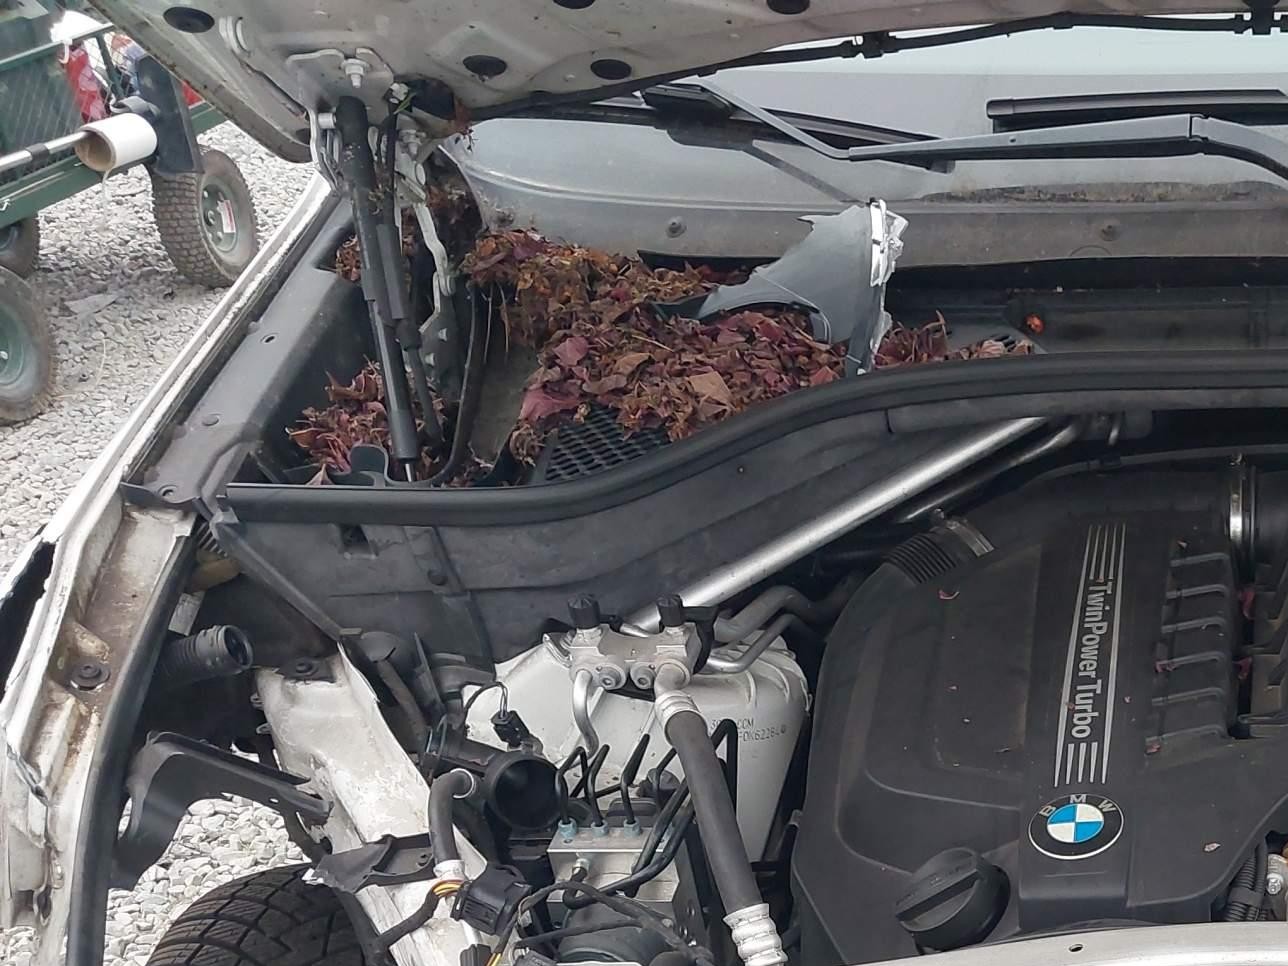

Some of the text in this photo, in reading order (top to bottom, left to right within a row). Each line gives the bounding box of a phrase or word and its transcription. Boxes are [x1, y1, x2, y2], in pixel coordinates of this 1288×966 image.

[1071, 581, 1113, 739] TwinPower Turbo
[1038, 794, 1117, 818] BMW
